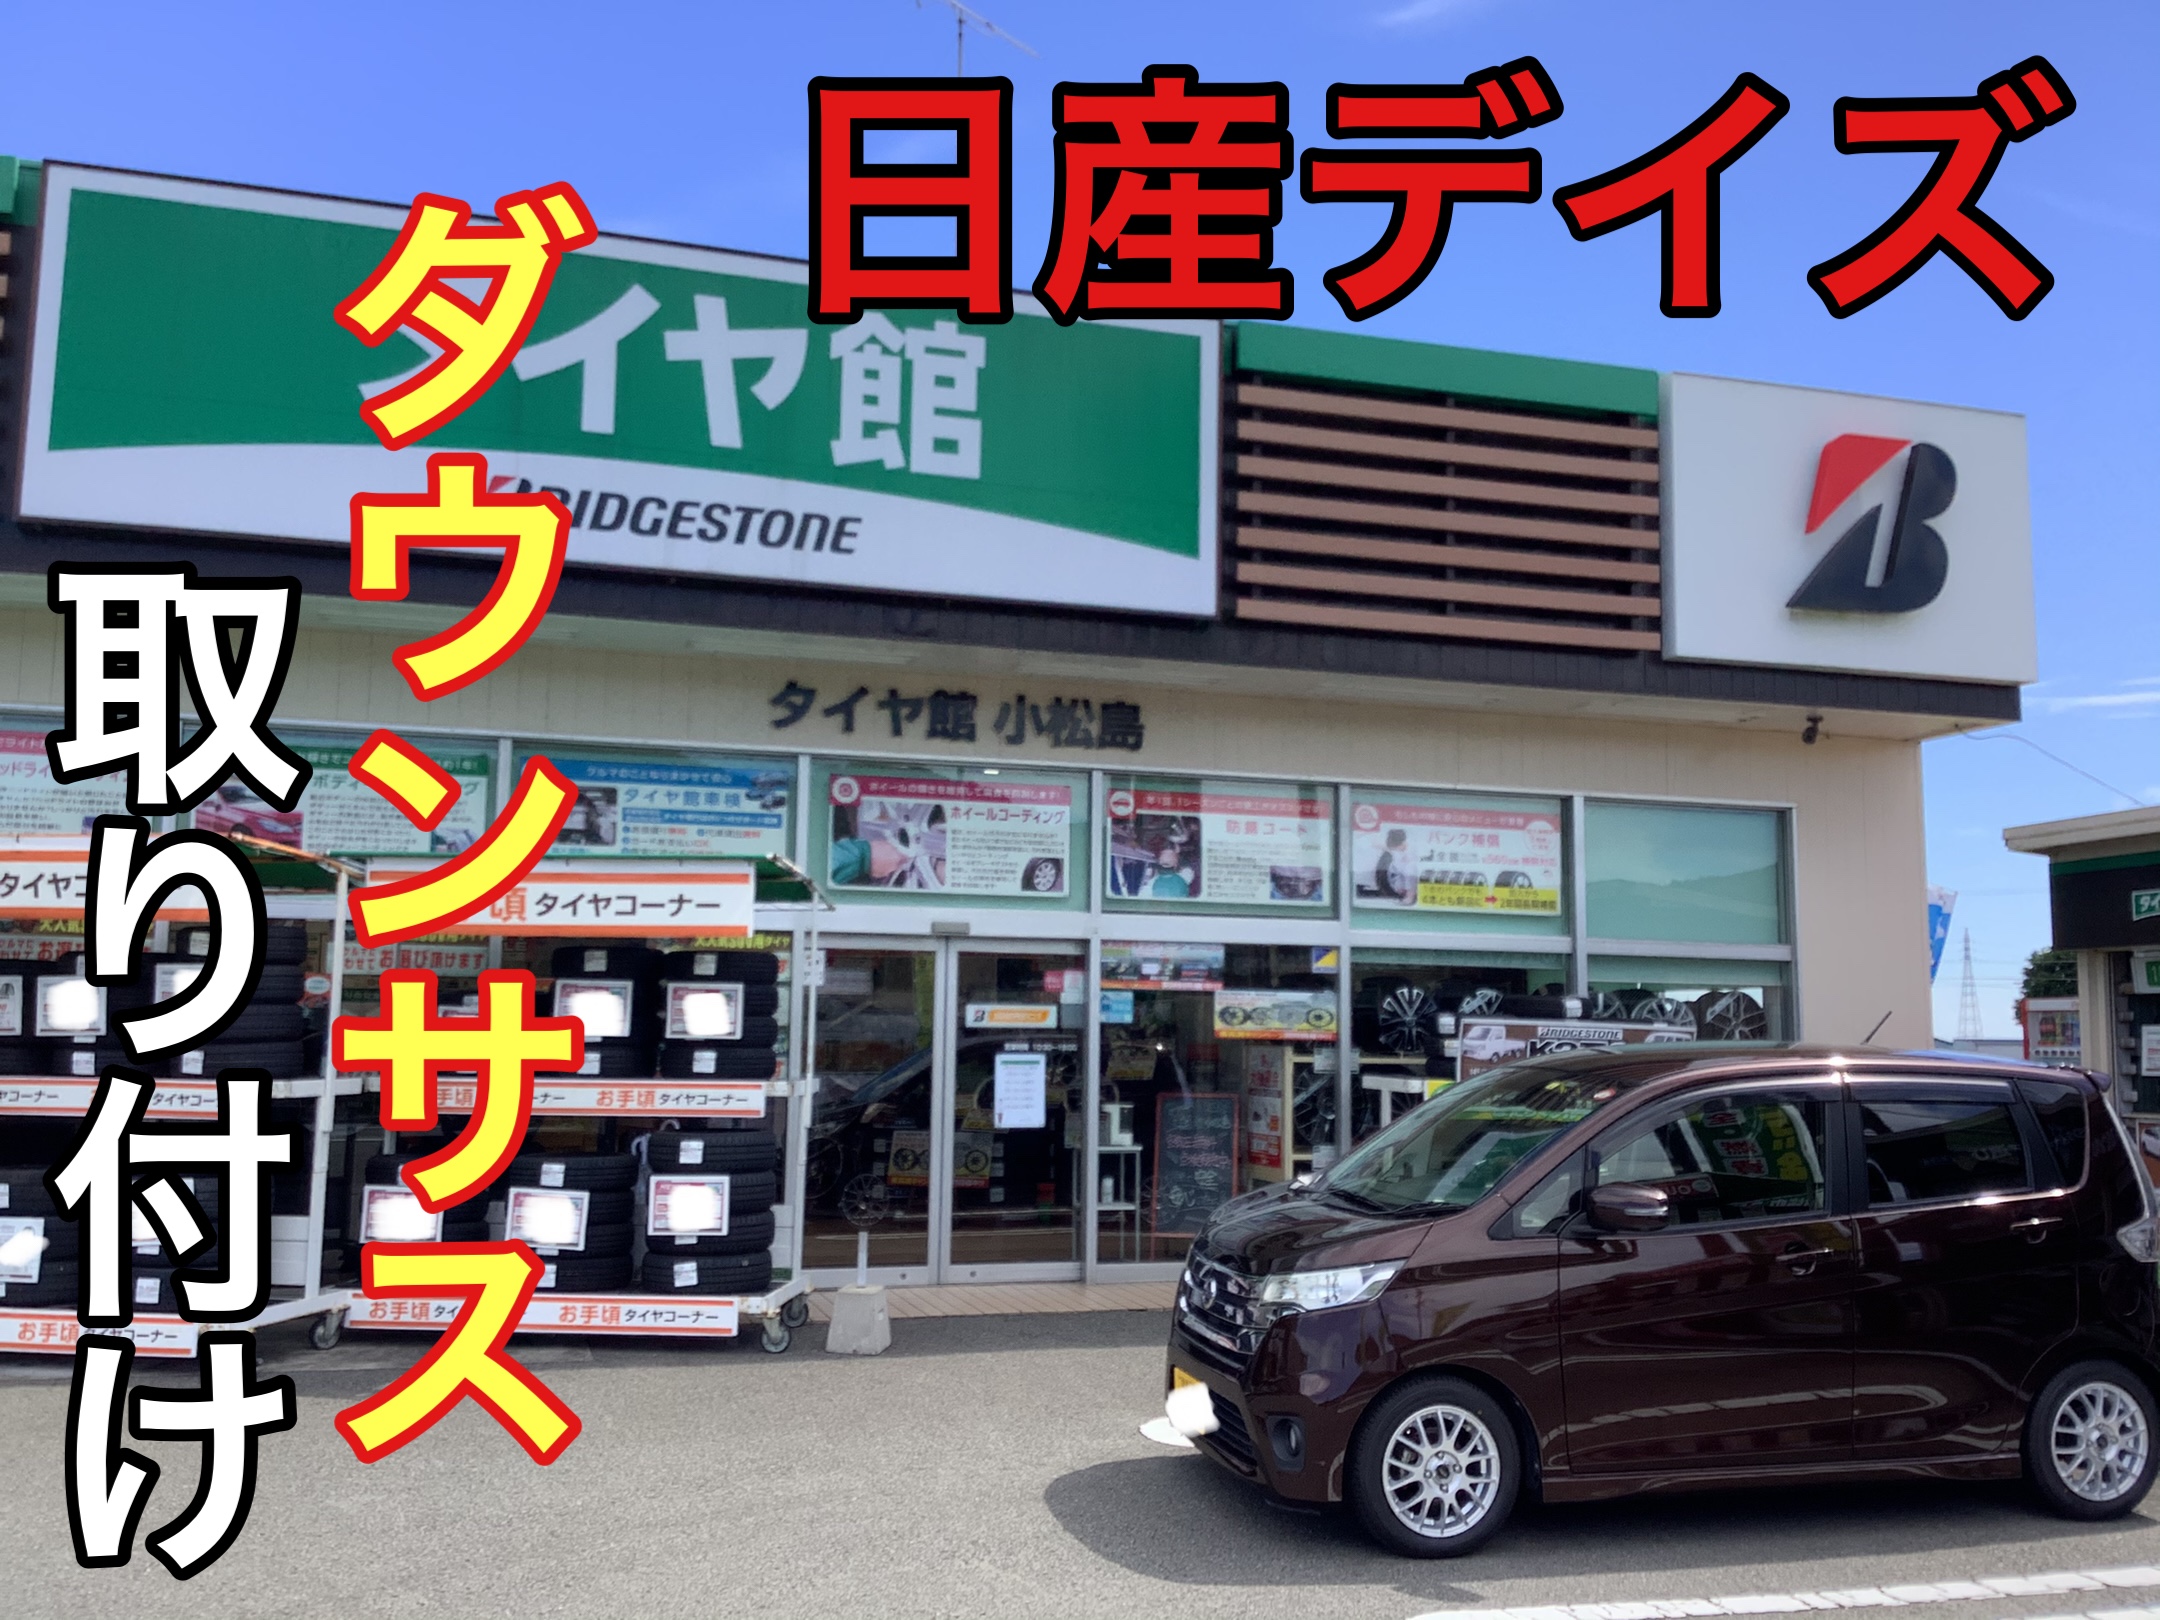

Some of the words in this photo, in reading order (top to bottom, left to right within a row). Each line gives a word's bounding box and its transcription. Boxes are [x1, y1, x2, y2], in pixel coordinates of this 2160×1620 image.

[358, 283, 987, 479] イヤ館
[768, 680, 978, 743] タイヤ館
[993, 694, 1145, 752] 小松島
[951, 806, 1066, 826] ホイールコーティング
[535, 893, 721, 918] タイヤコーナー
[41, 920, 84, 933] 大人気
[1540, 1028, 1621, 1040] BRIDGESTONE
[152, 1093, 218, 1107] タイヤコー
[596, 1089, 656, 1108] お手頃
[659, 1093, 748, 1105] タイヤコーナー
[369, 1301, 430, 1321] お手頃
[558, 1304, 620, 1324] お手頃
[624, 1308, 719, 1323] タイヤコーナー
[18, 1321, 79, 1343] お手頃
